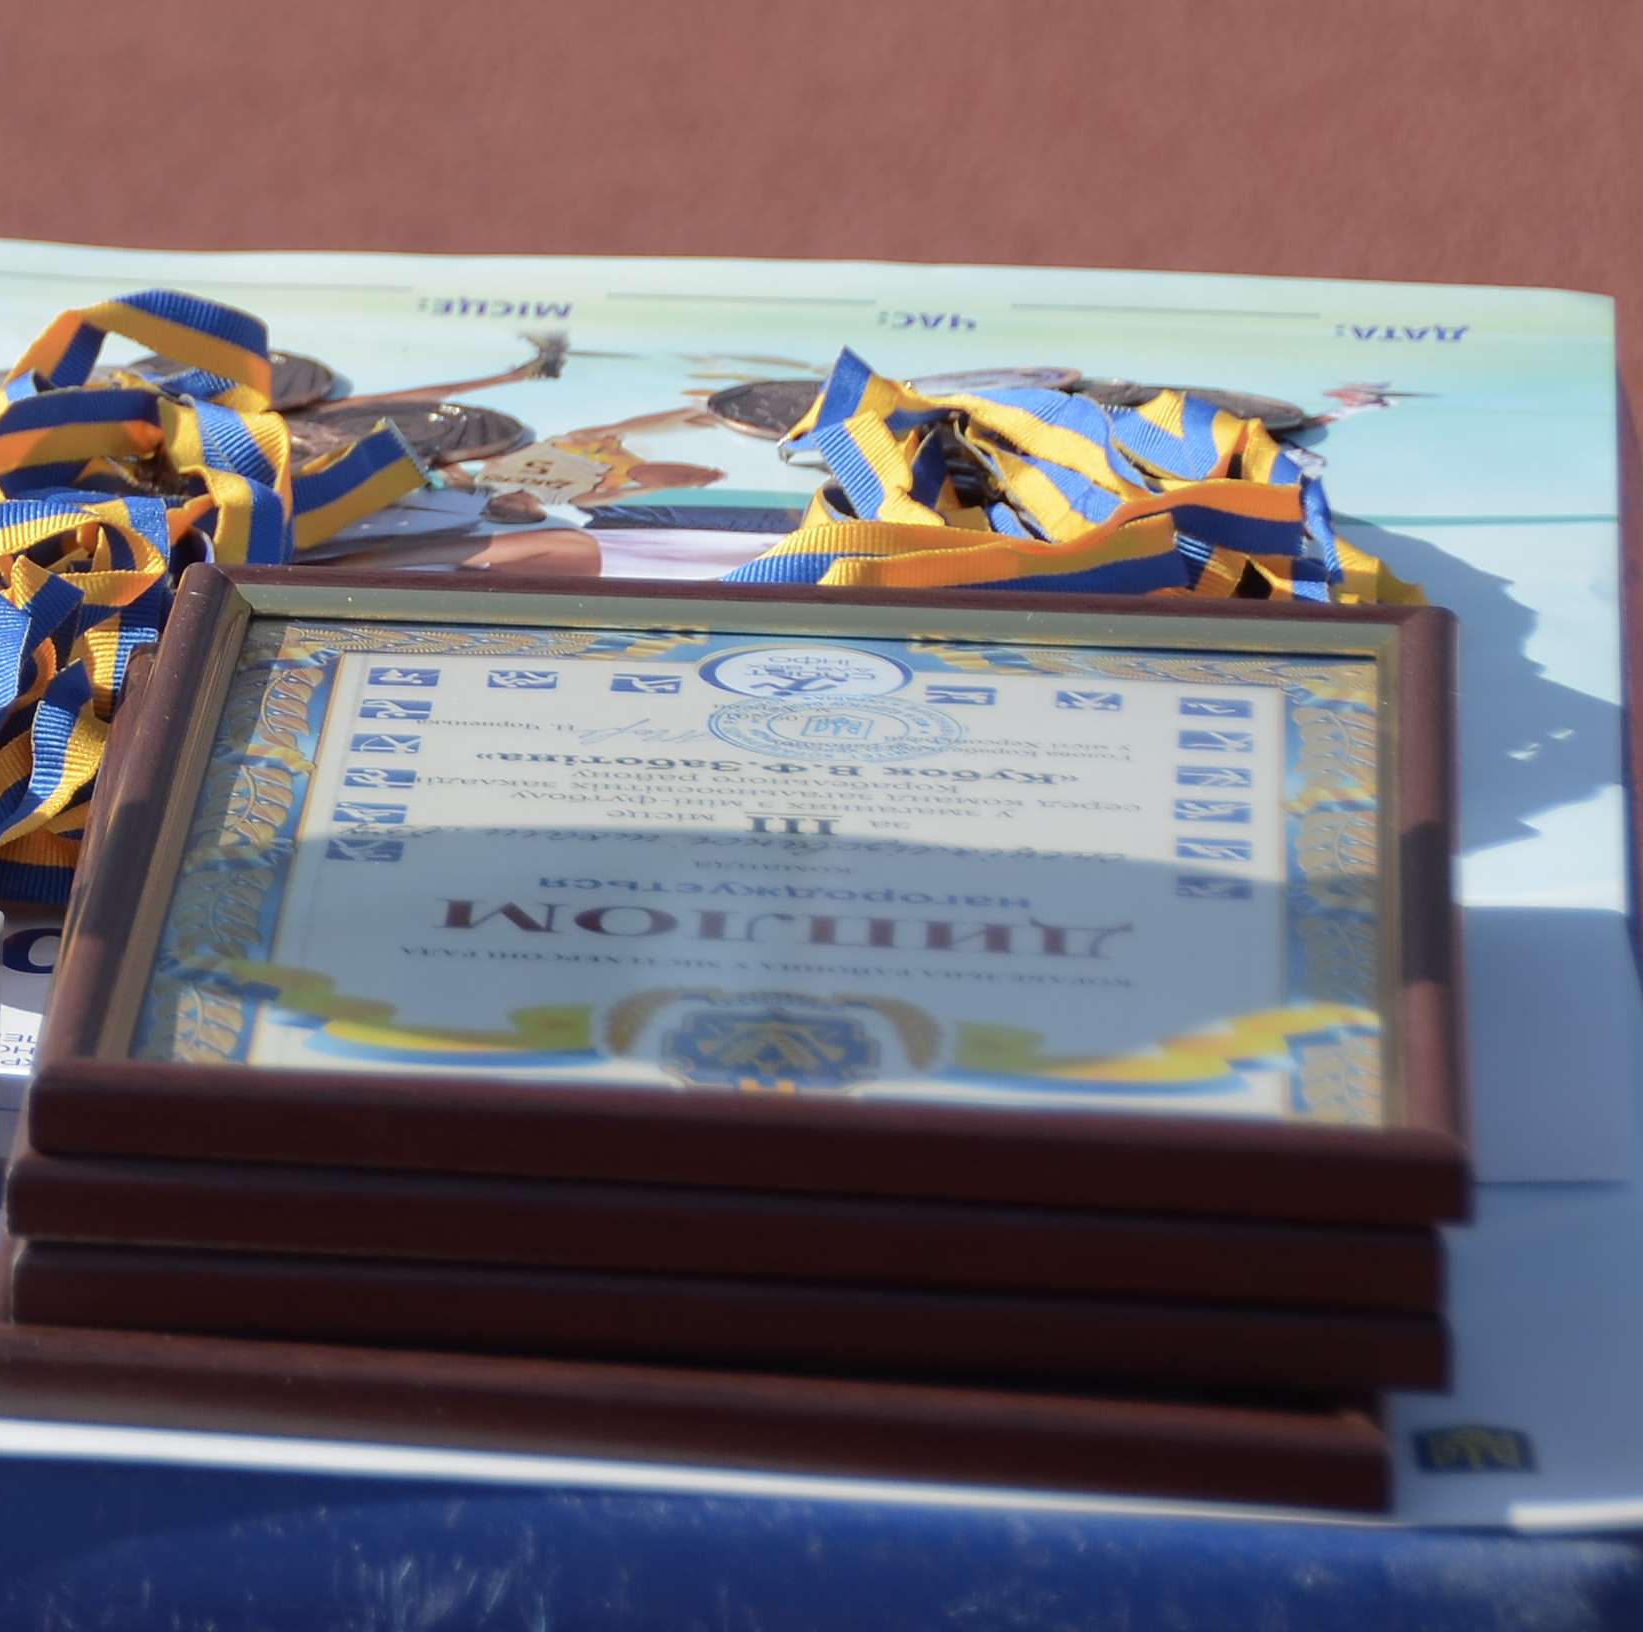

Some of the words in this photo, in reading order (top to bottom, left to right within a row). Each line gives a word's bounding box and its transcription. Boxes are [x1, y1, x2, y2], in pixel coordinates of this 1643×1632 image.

[882, 766, 1079, 785] «Кубок
[1036, 799, 1143, 813] серед
[537, 876, 1031, 910] нагороджується
[435, 899, 1135, 960] ДИПЛОМ
